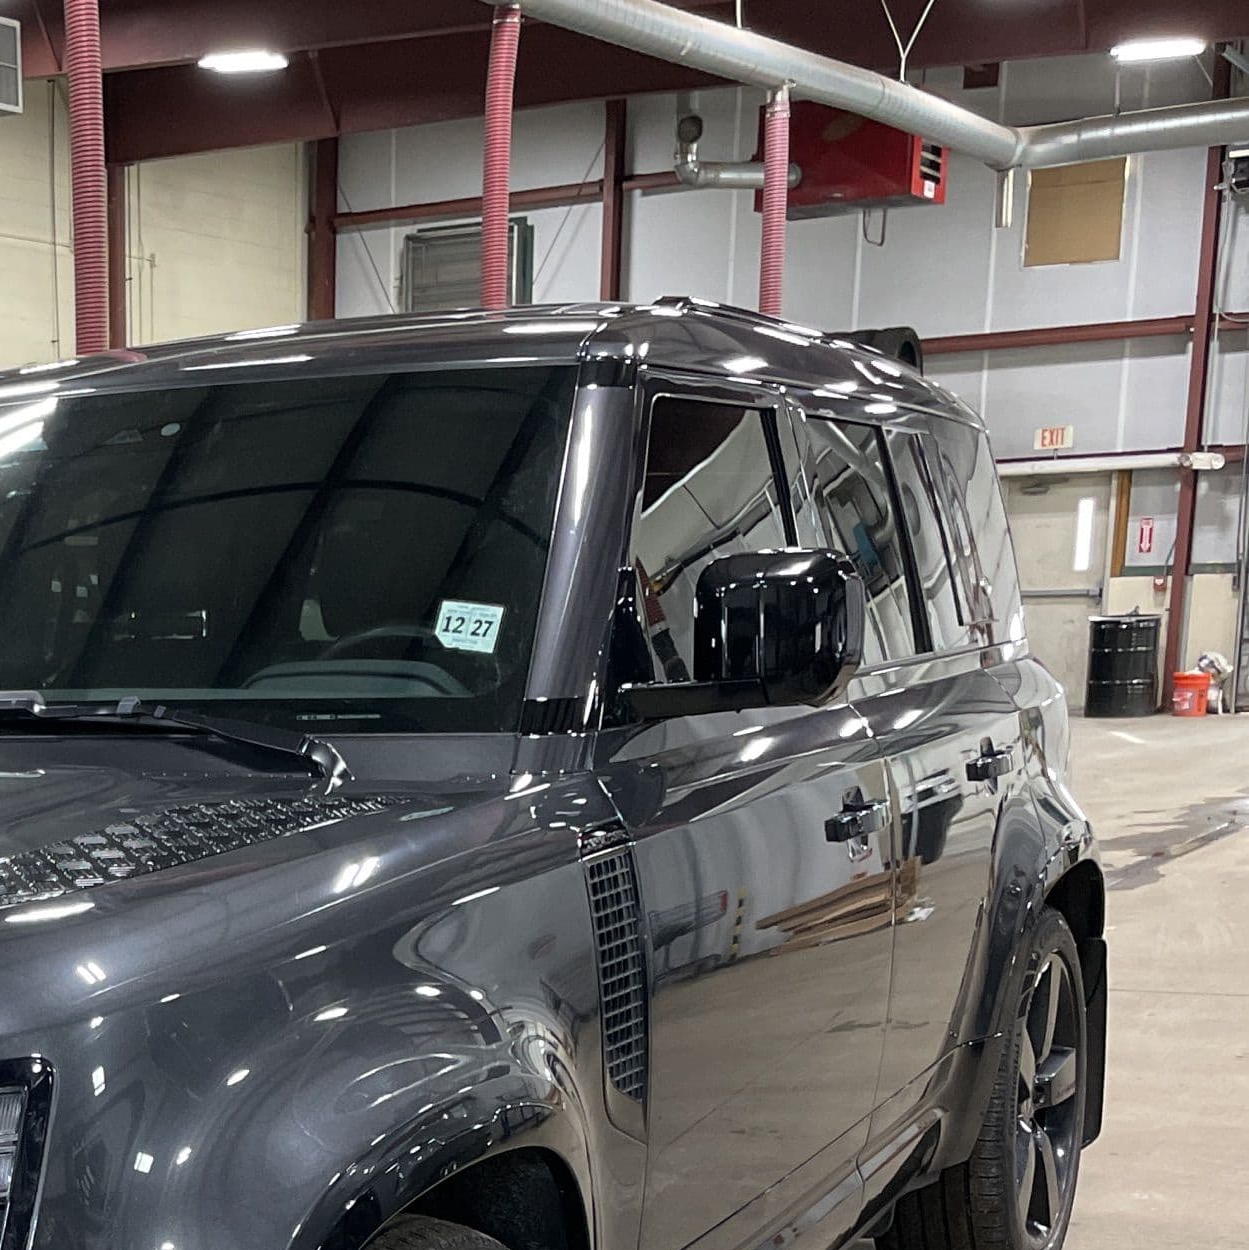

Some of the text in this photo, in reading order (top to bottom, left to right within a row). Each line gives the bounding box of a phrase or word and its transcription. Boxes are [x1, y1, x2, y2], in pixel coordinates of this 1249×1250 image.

[1041, 427, 1065, 448] EXIT
[442, 616, 494, 637] 12 27
